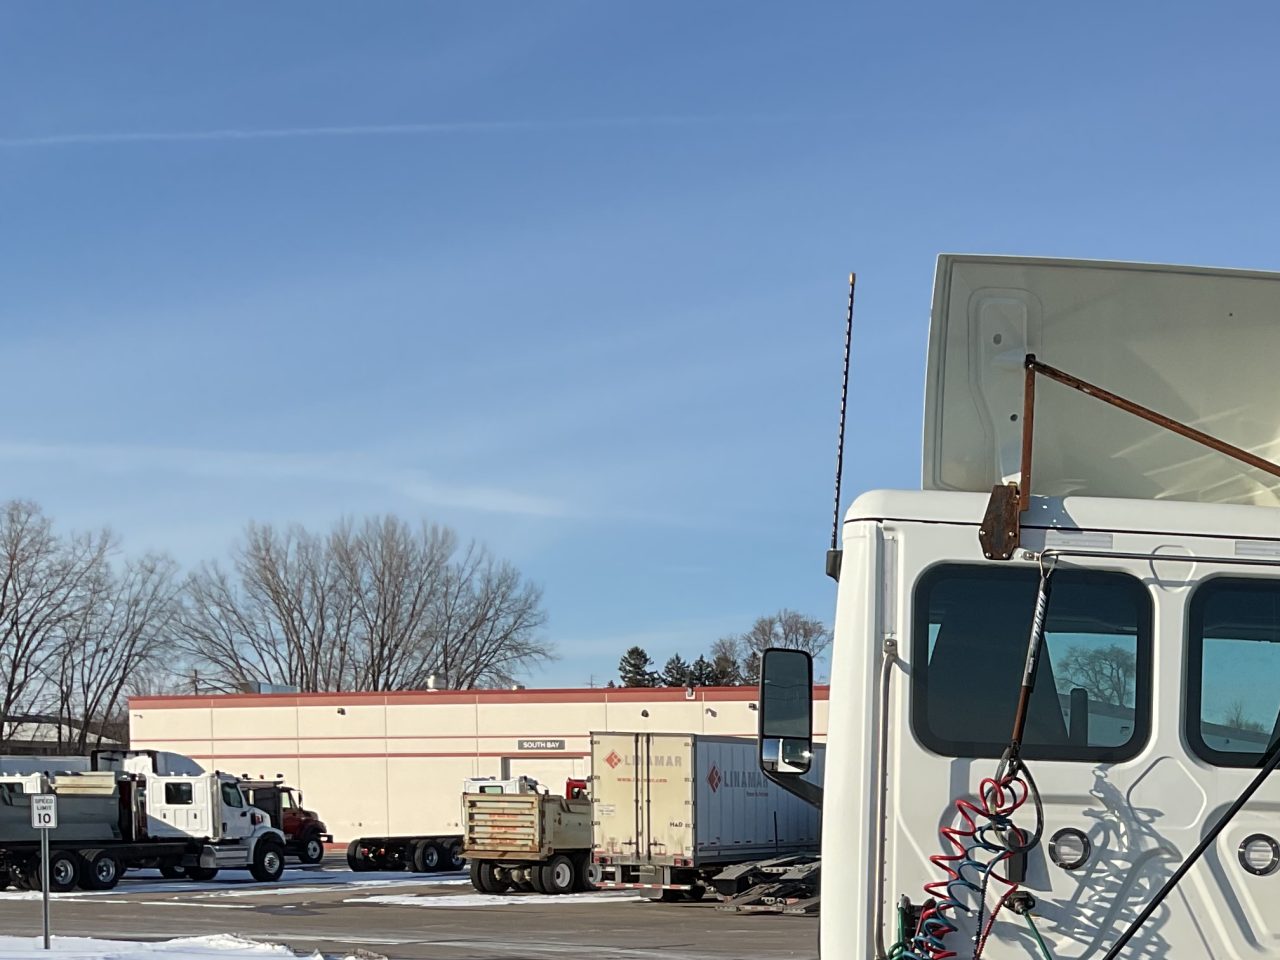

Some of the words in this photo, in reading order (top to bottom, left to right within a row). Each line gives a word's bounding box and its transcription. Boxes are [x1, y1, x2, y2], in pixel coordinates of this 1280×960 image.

[523, 741, 546, 749] SOUTH
[546, 741, 560, 749] BAY
[37, 813, 51, 824] 10
